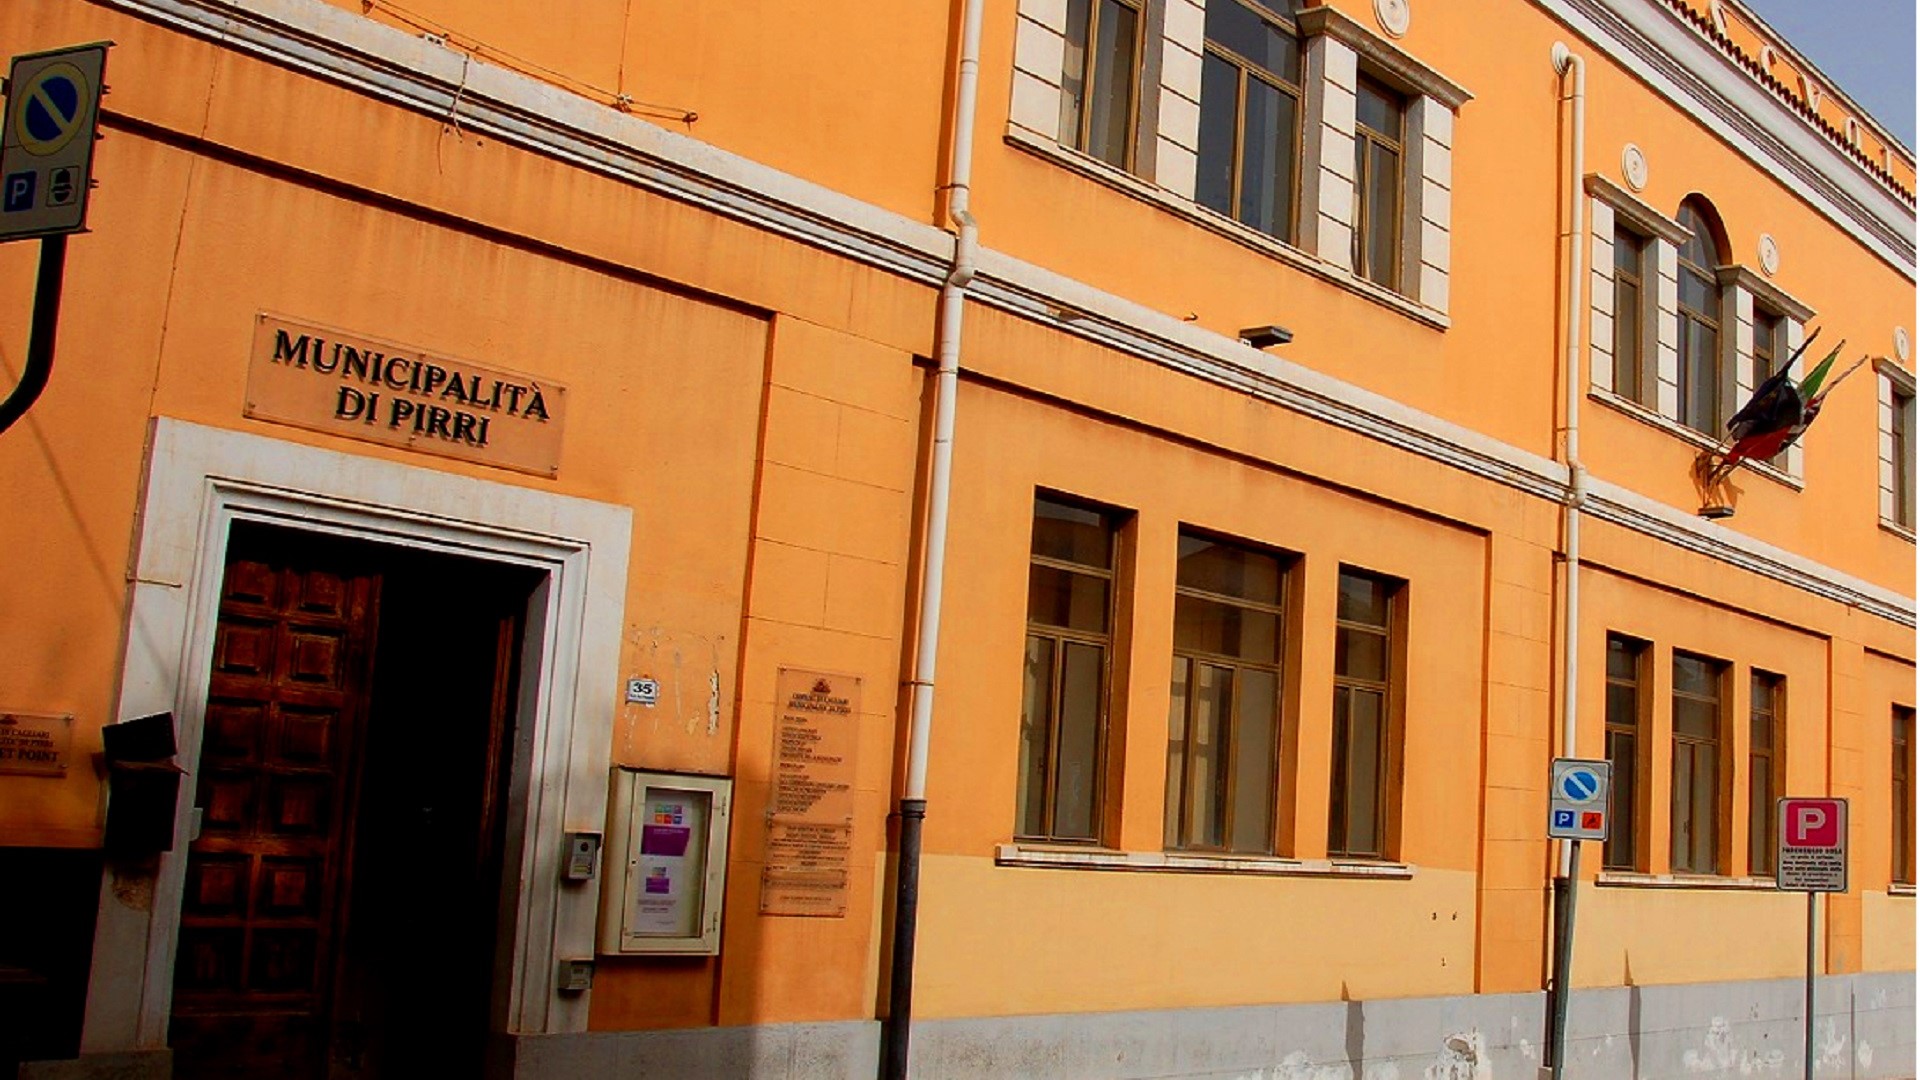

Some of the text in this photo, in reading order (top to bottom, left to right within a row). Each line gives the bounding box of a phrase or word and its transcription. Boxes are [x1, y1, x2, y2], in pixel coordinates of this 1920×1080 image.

[11, 179, 28, 205] P
[272, 329, 549, 420] MUNICIPALITÀ
[335, 386, 490, 447] DI PIRRI
[633, 682, 652, 694] 35
[1559, 813, 1570, 825] P
[1798, 807, 1826, 840] P
